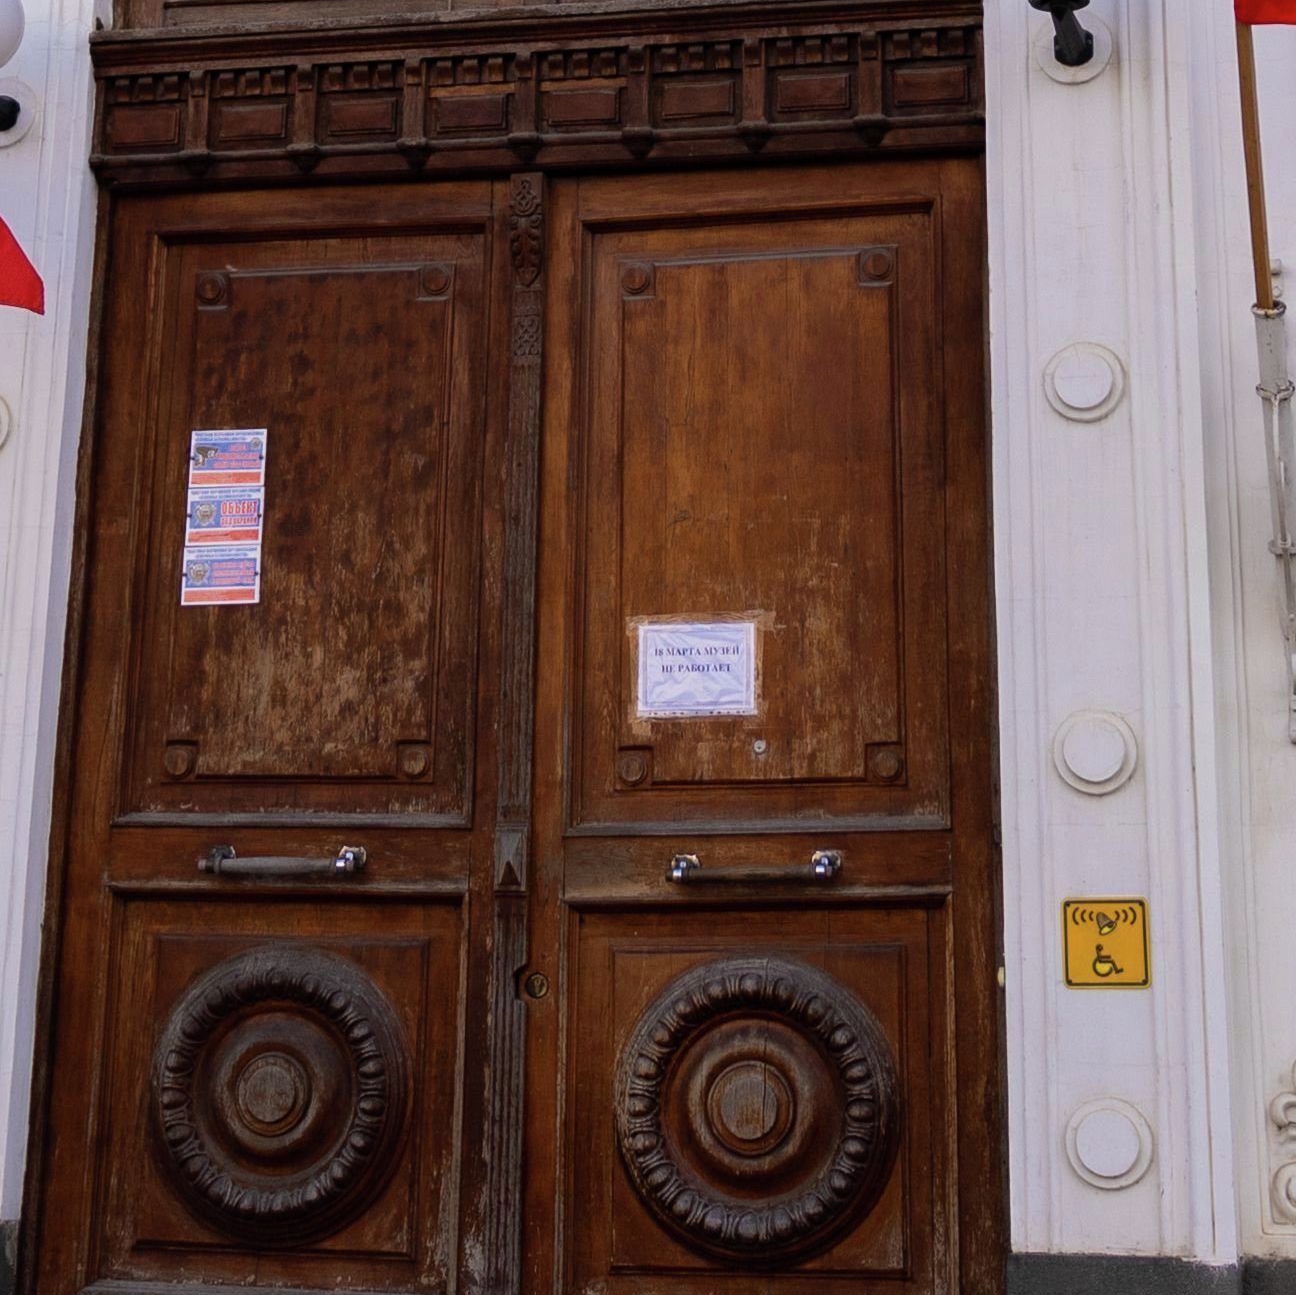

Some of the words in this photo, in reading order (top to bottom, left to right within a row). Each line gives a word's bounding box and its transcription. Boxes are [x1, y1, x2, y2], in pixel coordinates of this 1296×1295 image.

[666, 647, 702, 657] МАРТА
[704, 645, 740, 656] МУЗЕЙ
[661, 664, 675, 674] НЕ
[678, 663, 731, 673] РАБОТАЕТ
